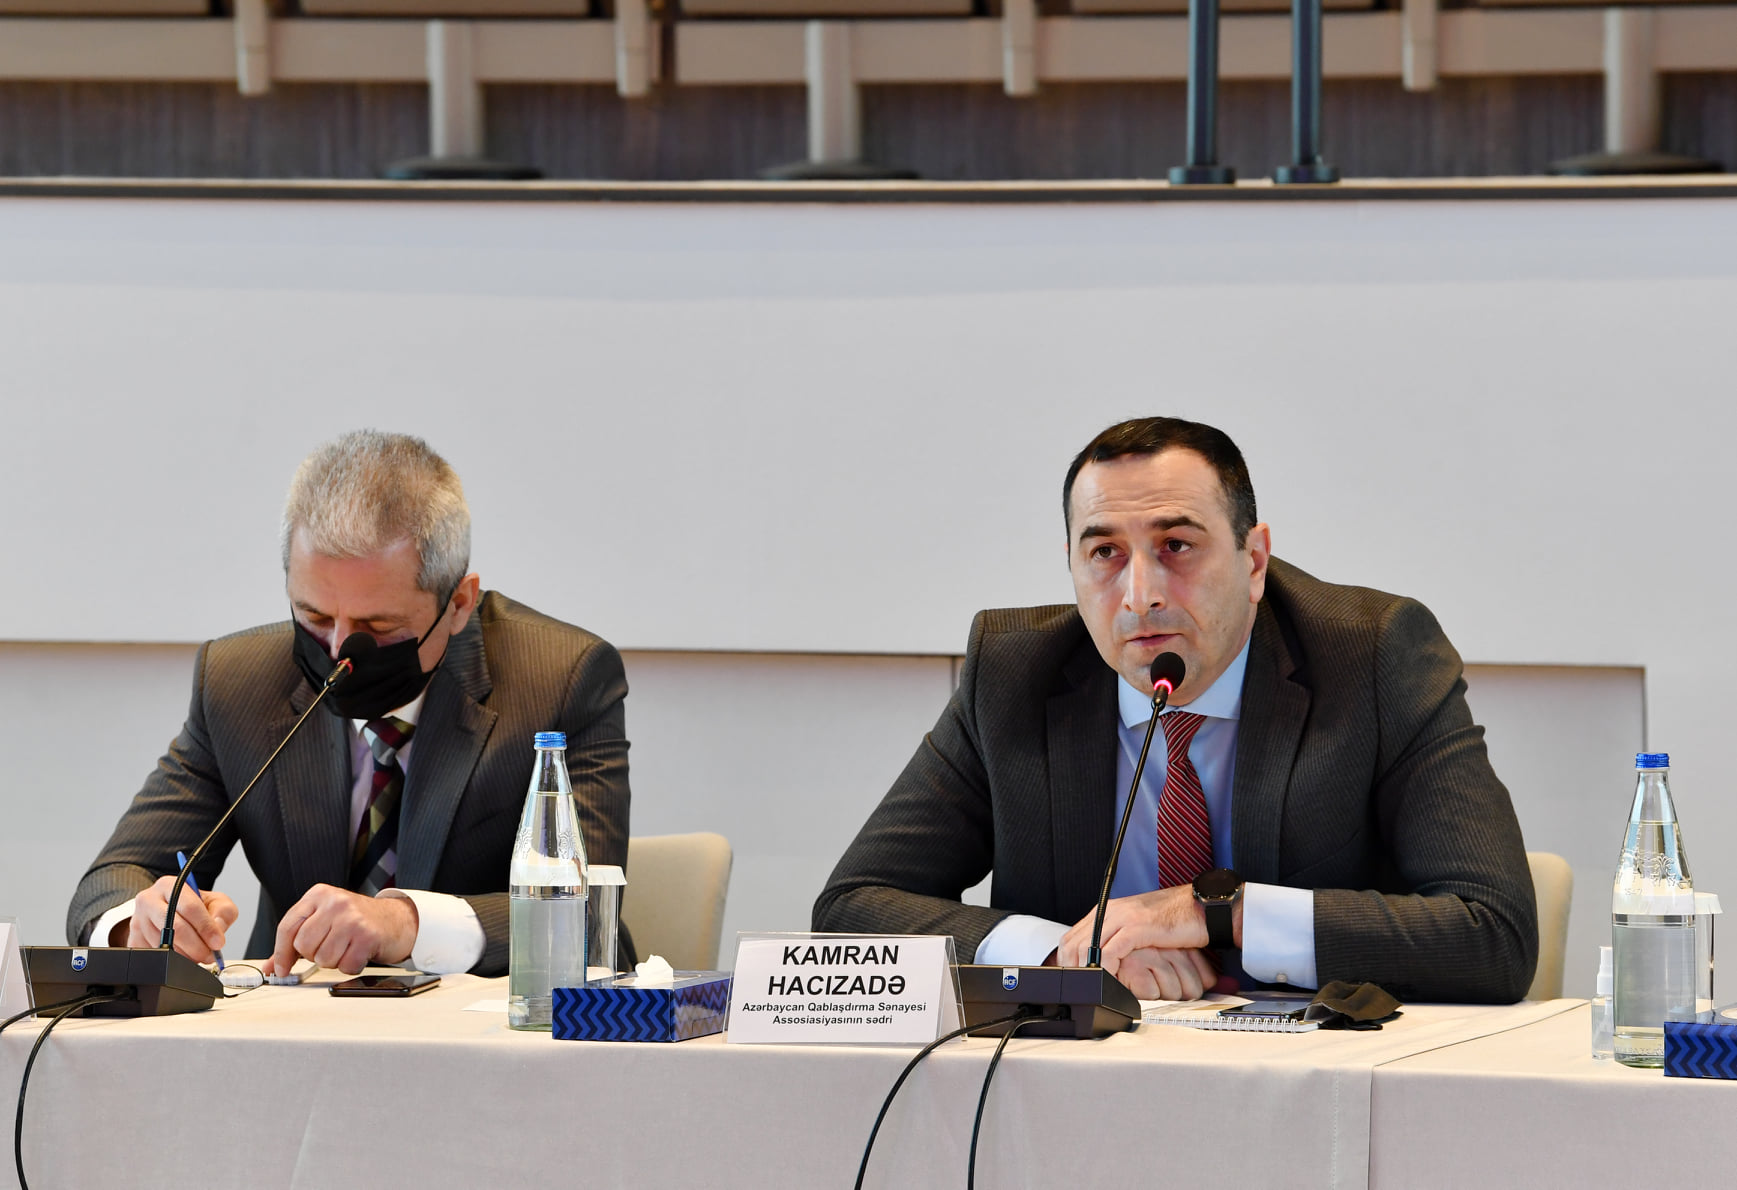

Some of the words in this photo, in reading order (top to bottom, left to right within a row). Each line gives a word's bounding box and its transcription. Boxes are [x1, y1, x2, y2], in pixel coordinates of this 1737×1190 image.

[782, 945, 899, 966] KAMRAN
[767, 975, 906, 996] HACIZADƏ
[742, 1002, 805, 1014] Azərbaycan
[807, 1002, 875, 1014] Qablaşdırma
[878, 1002, 927, 1014] Sənayesi
[772, 1015, 863, 1026] Assosiasiyasının
[866, 1015, 893, 1025] sədri
